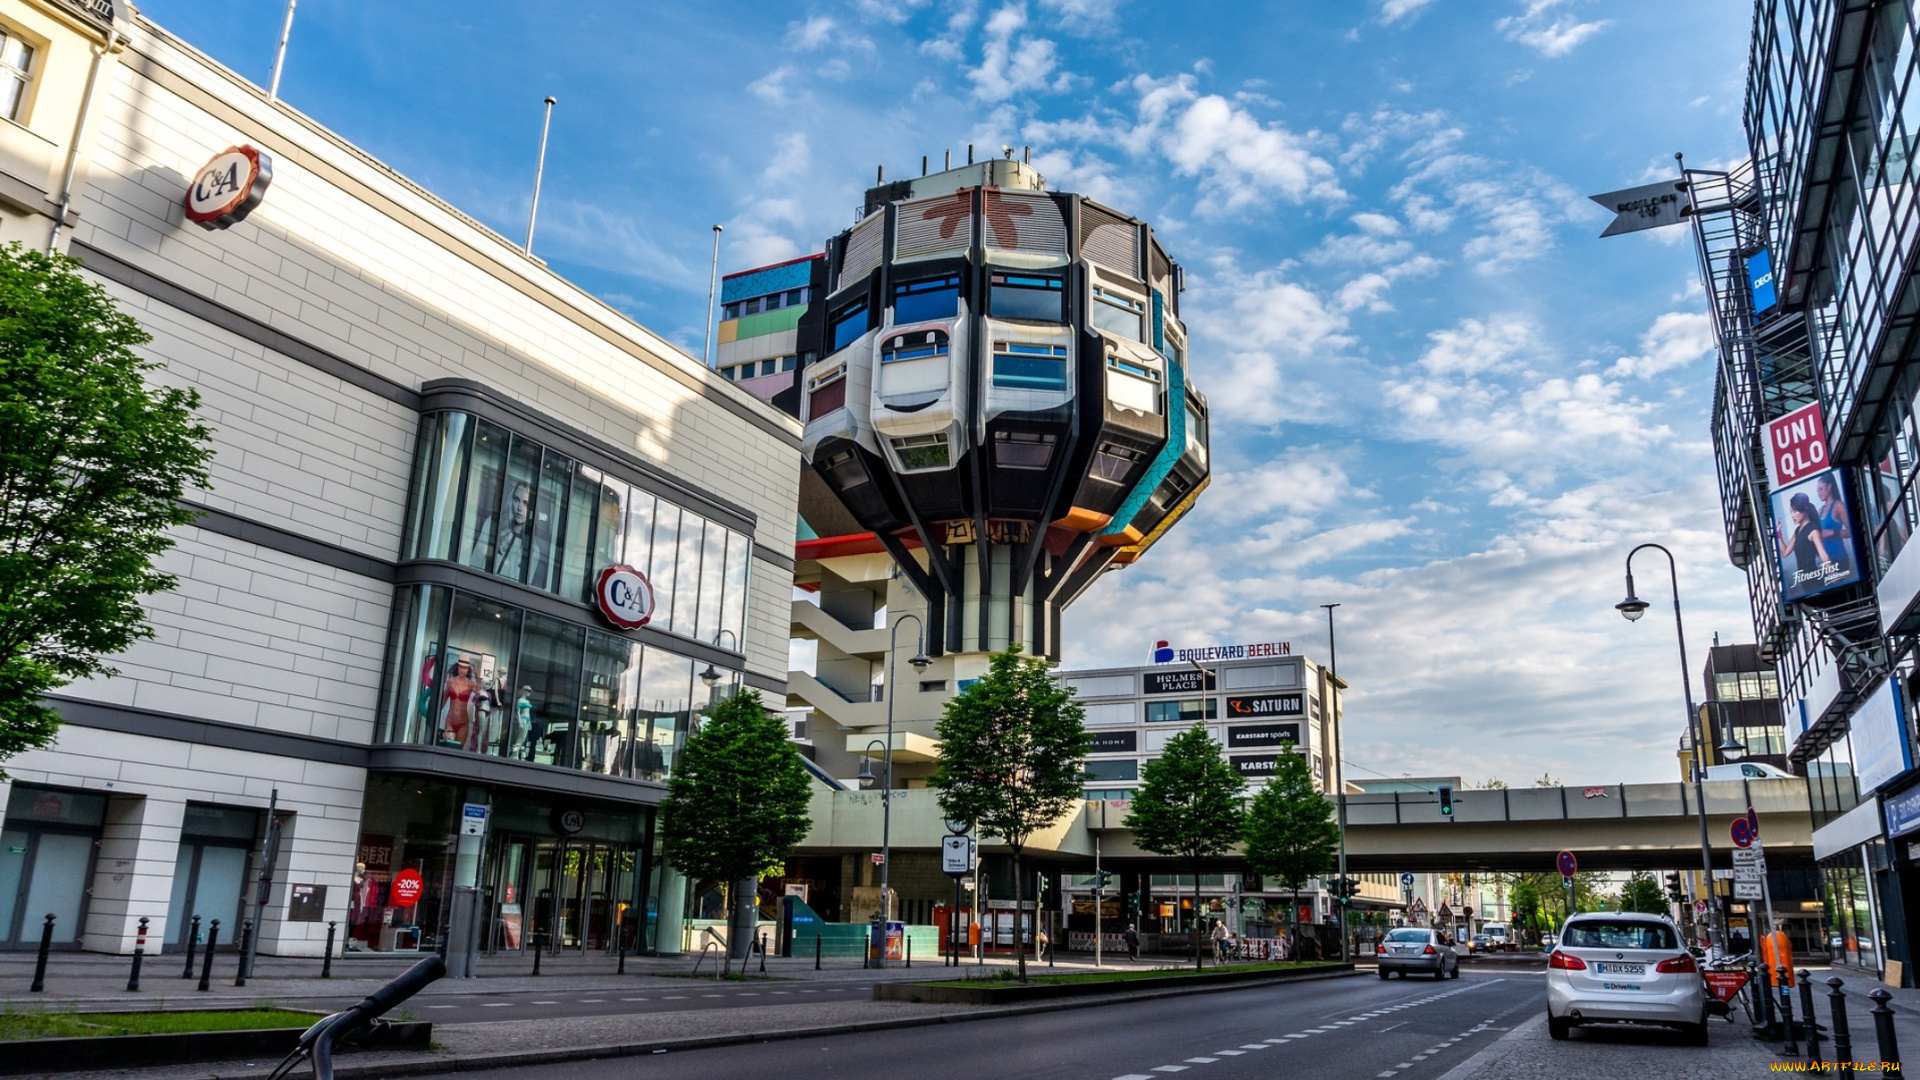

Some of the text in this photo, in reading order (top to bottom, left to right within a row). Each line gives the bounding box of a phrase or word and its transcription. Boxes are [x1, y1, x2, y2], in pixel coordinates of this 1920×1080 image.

[196, 161, 240, 202] C&A
[1775, 413, 1816, 449] UNI
[1781, 440, 1824, 478] QLO
[1824, 569, 1850, 584] platinum
[611, 579, 645, 614] C&A
[1179, 642, 1290, 662] BOULEVARD BERLIN
[1156, 673, 1203, 683] HOLMES
[1162, 682, 1197, 690] PLACE
[1252, 698, 1300, 713] SATURN
[1270, 730, 1290, 739] sports
[361, 845, 391, 857] BEST
[397, 879, 420, 890] -20%
